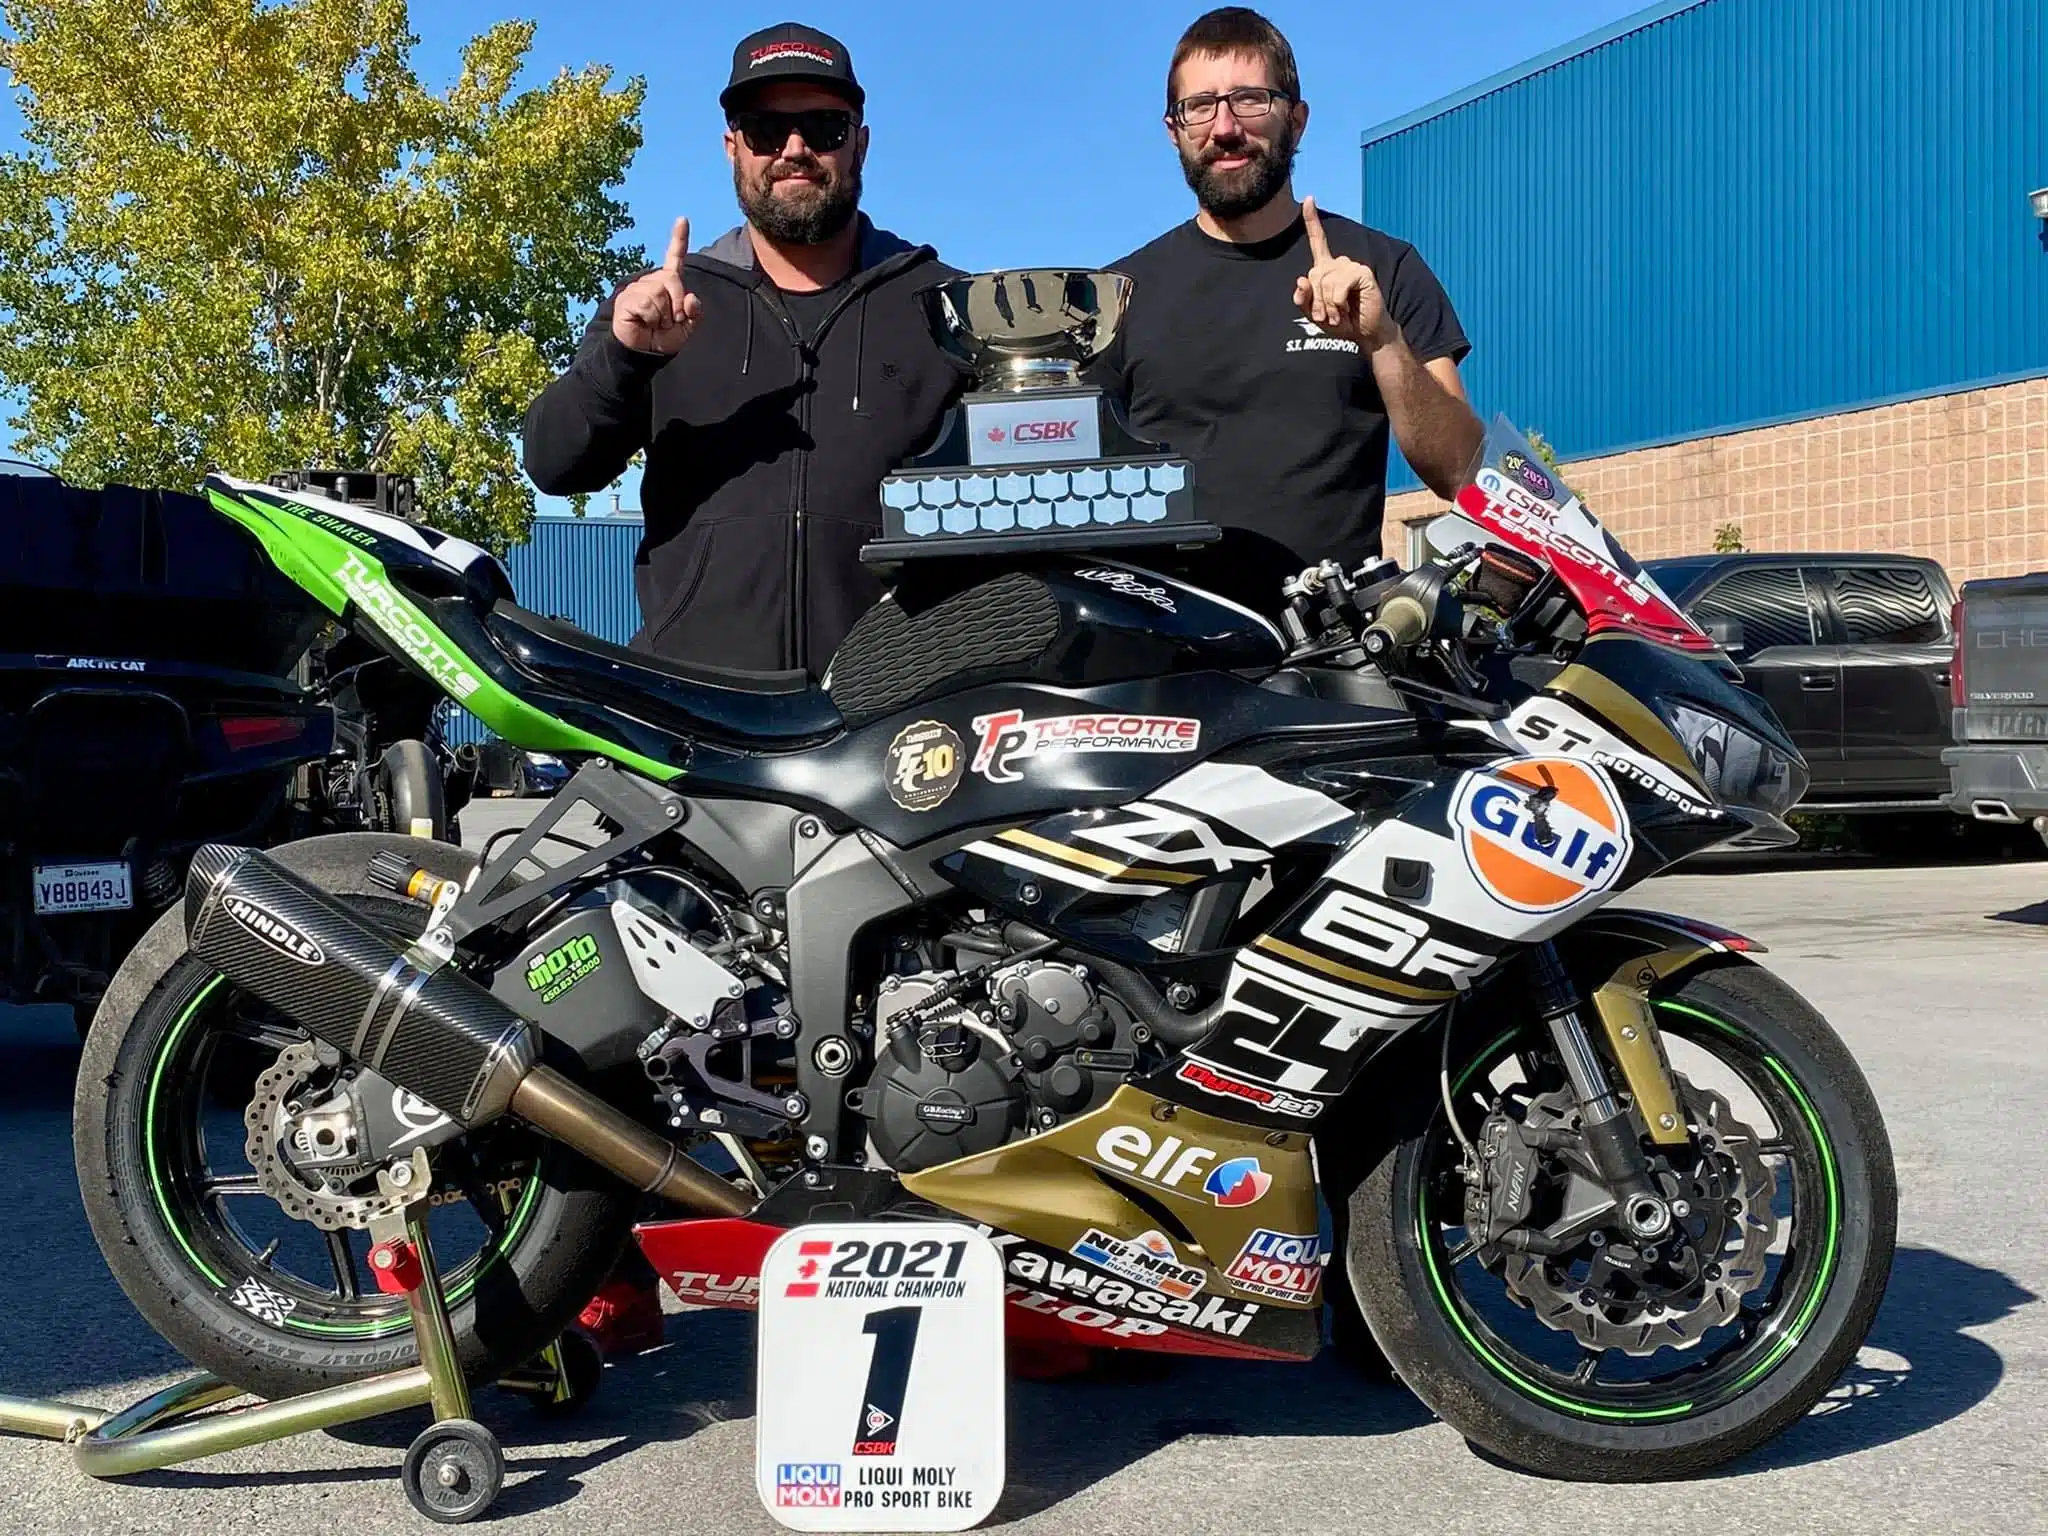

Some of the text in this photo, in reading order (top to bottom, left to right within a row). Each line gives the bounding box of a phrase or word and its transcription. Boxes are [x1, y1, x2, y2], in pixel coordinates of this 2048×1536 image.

[1013, 420, 1080, 442] CSBK
[1522, 466, 1549, 489] 2021
[1505, 487, 1560, 526] CSBK
[280, 501, 378, 547] THE SHAKER
[1483, 491, 1651, 606] TURCOTTE
[331, 569, 472, 700] PERFORMANCE
[339, 550, 482, 692] TURCOTTE
[66, 658, 146, 671] ARCTIC CAT
[1034, 717, 1197, 738] TURCOTTE
[1034, 736, 1193, 750] PERFORMANCE
[1592, 751, 1724, 820] MOTOSPORT
[1470, 785, 1618, 881] Gulf
[231, 901, 315, 959] HINDLE
[1300, 889, 1498, 991] 6R
[527, 935, 597, 990] MOTO
[1096, 1125, 1217, 1187] elf
[827, 1240, 968, 1278] 2021
[1250, 1232, 1321, 1263] LIQU
[1112, 1256, 1165, 1282] RACING
[1235, 1257, 1321, 1291] MOLY
[825, 1280, 967, 1299] NATIONAL CHAMPION
[1248, 1282, 1264, 1294] PRO
[1264, 1286, 1293, 1300] SPORT
[1005, 1283, 1169, 1338] LOP
[852, 1305, 923, 1456] 1
[853, 1441, 896, 1455] CSBK
[779, 1464, 839, 1487] LIQUI
[858, 1467, 956, 1487] LIQUI MOLY
[778, 1487, 840, 1507] MOLY
[843, 1490, 973, 1508] PRO SPORT BIKE
